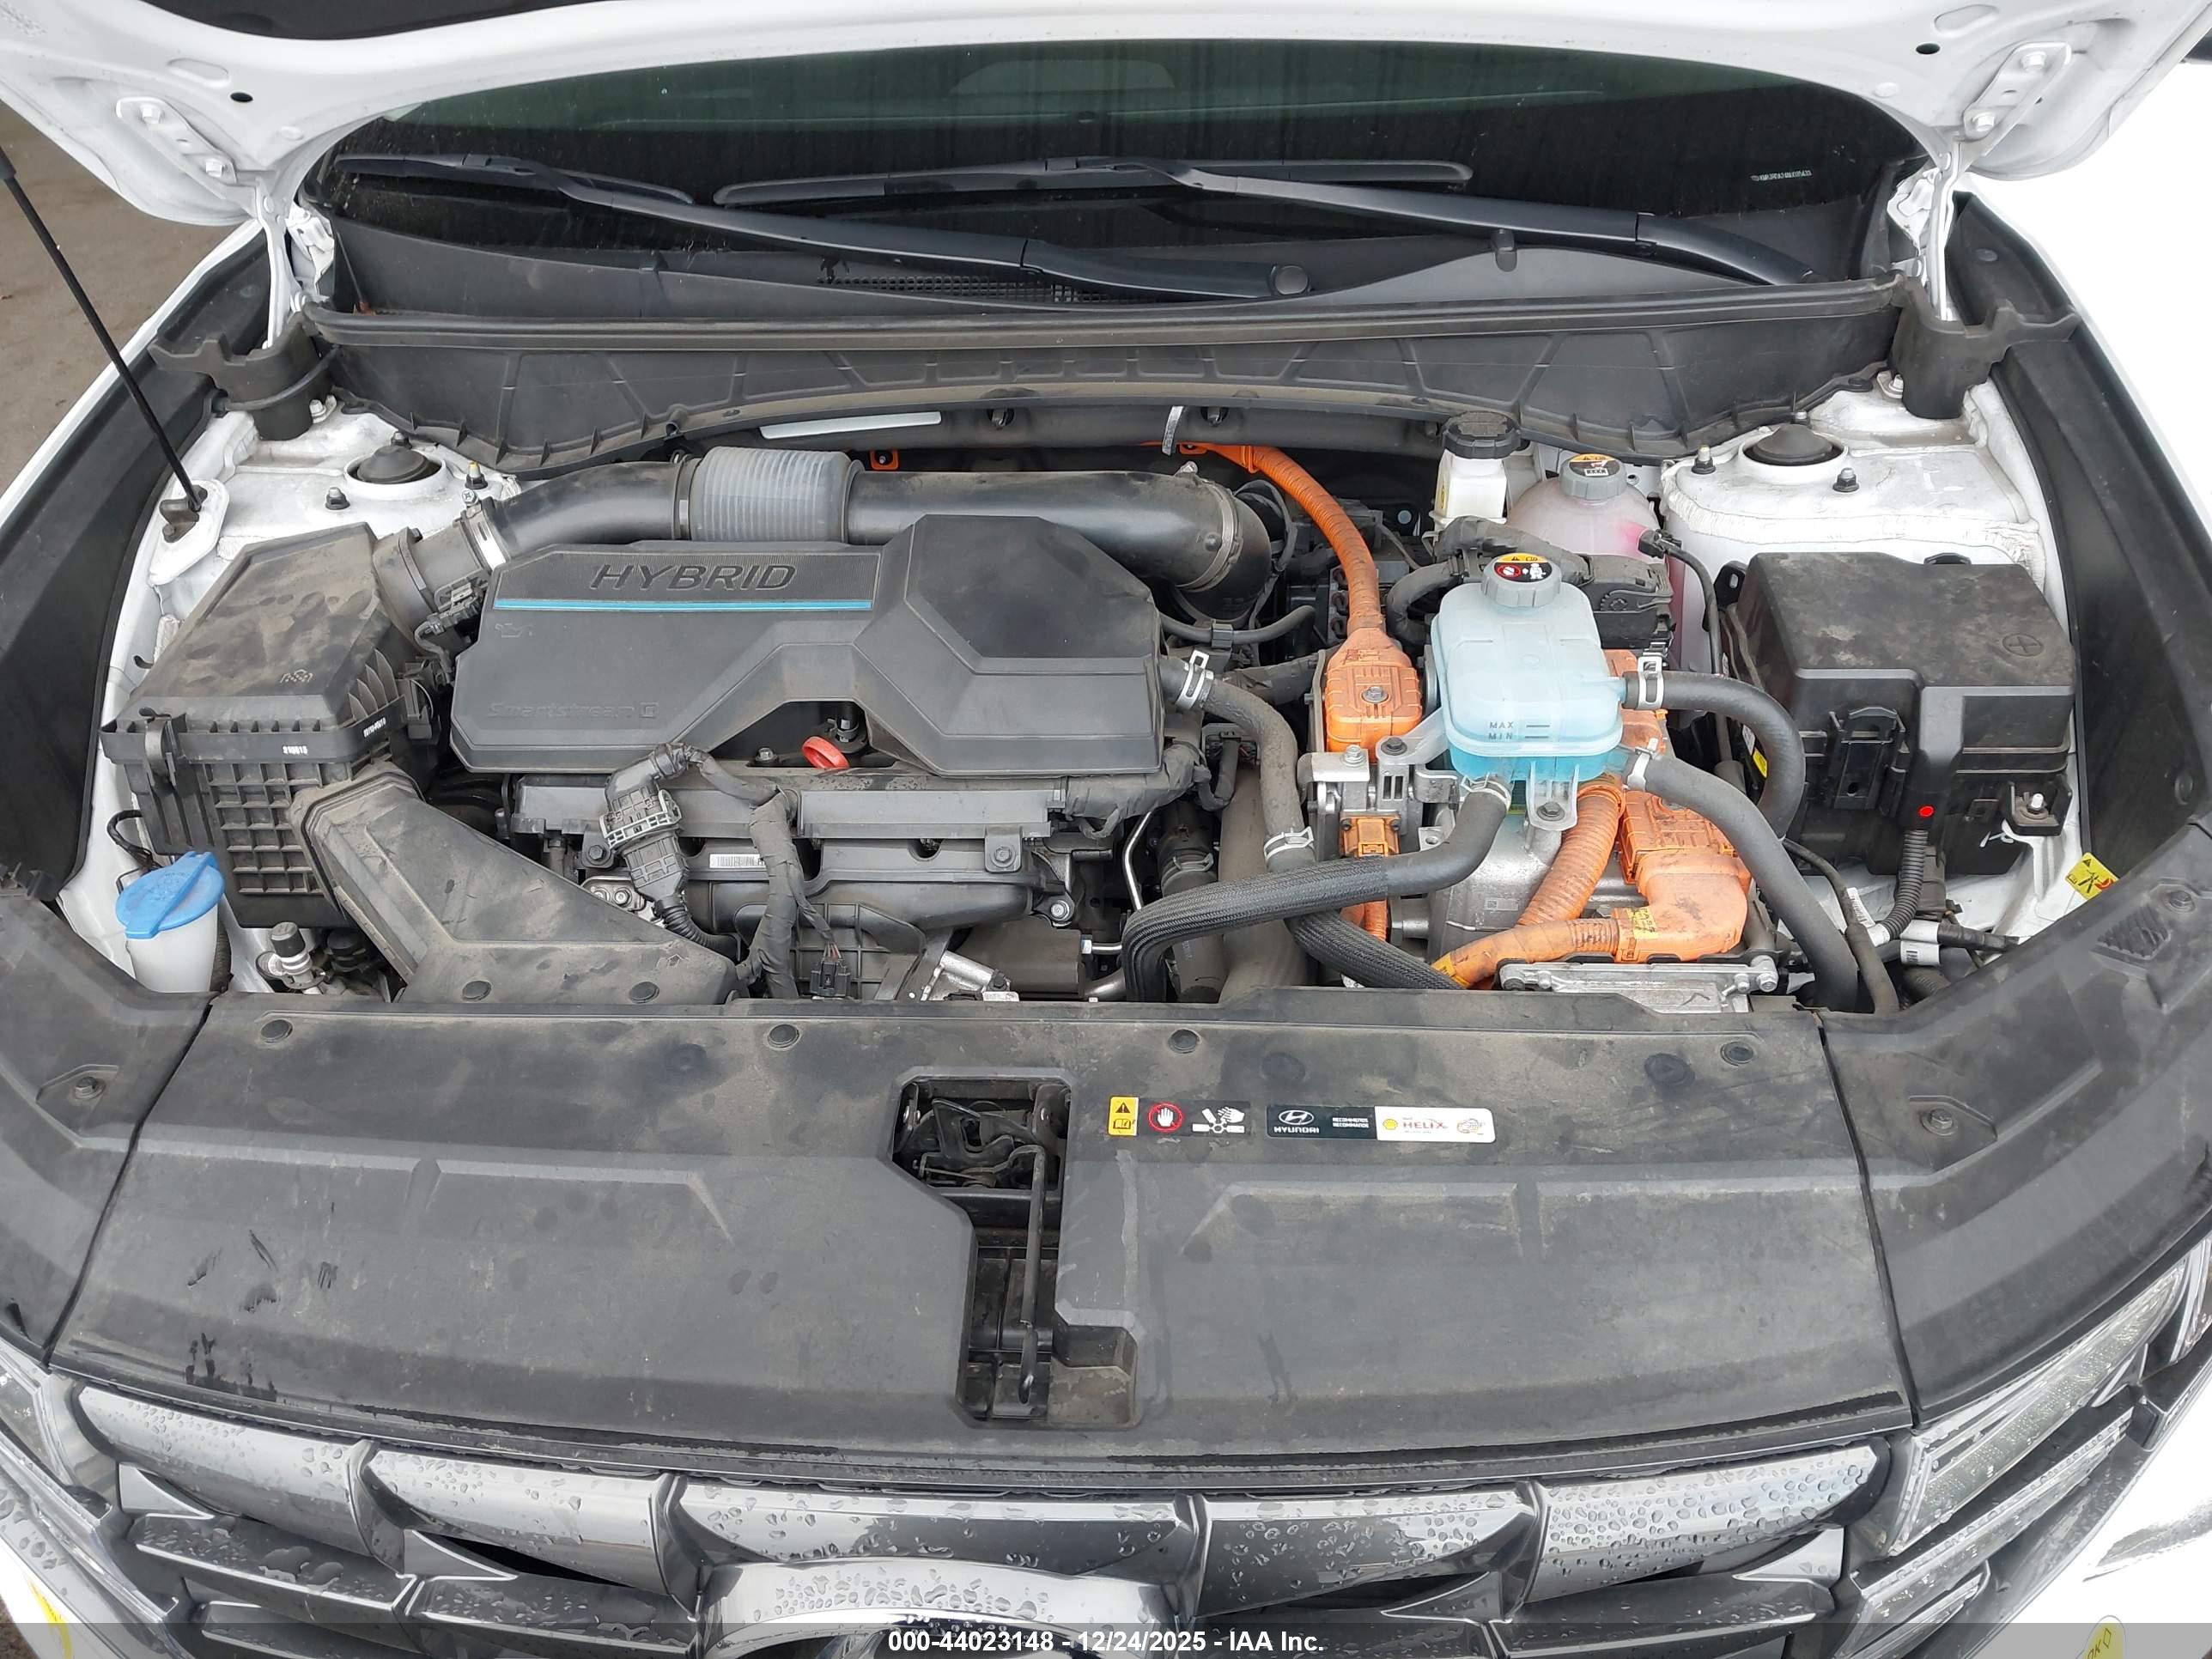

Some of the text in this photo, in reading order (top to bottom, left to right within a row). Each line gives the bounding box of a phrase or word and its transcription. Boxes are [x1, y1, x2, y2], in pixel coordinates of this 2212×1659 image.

[590, 564, 796, 591] HYBRID
[487, 701, 635, 720] Smartstream
[1403, 1121, 1444, 1129] HELIX
